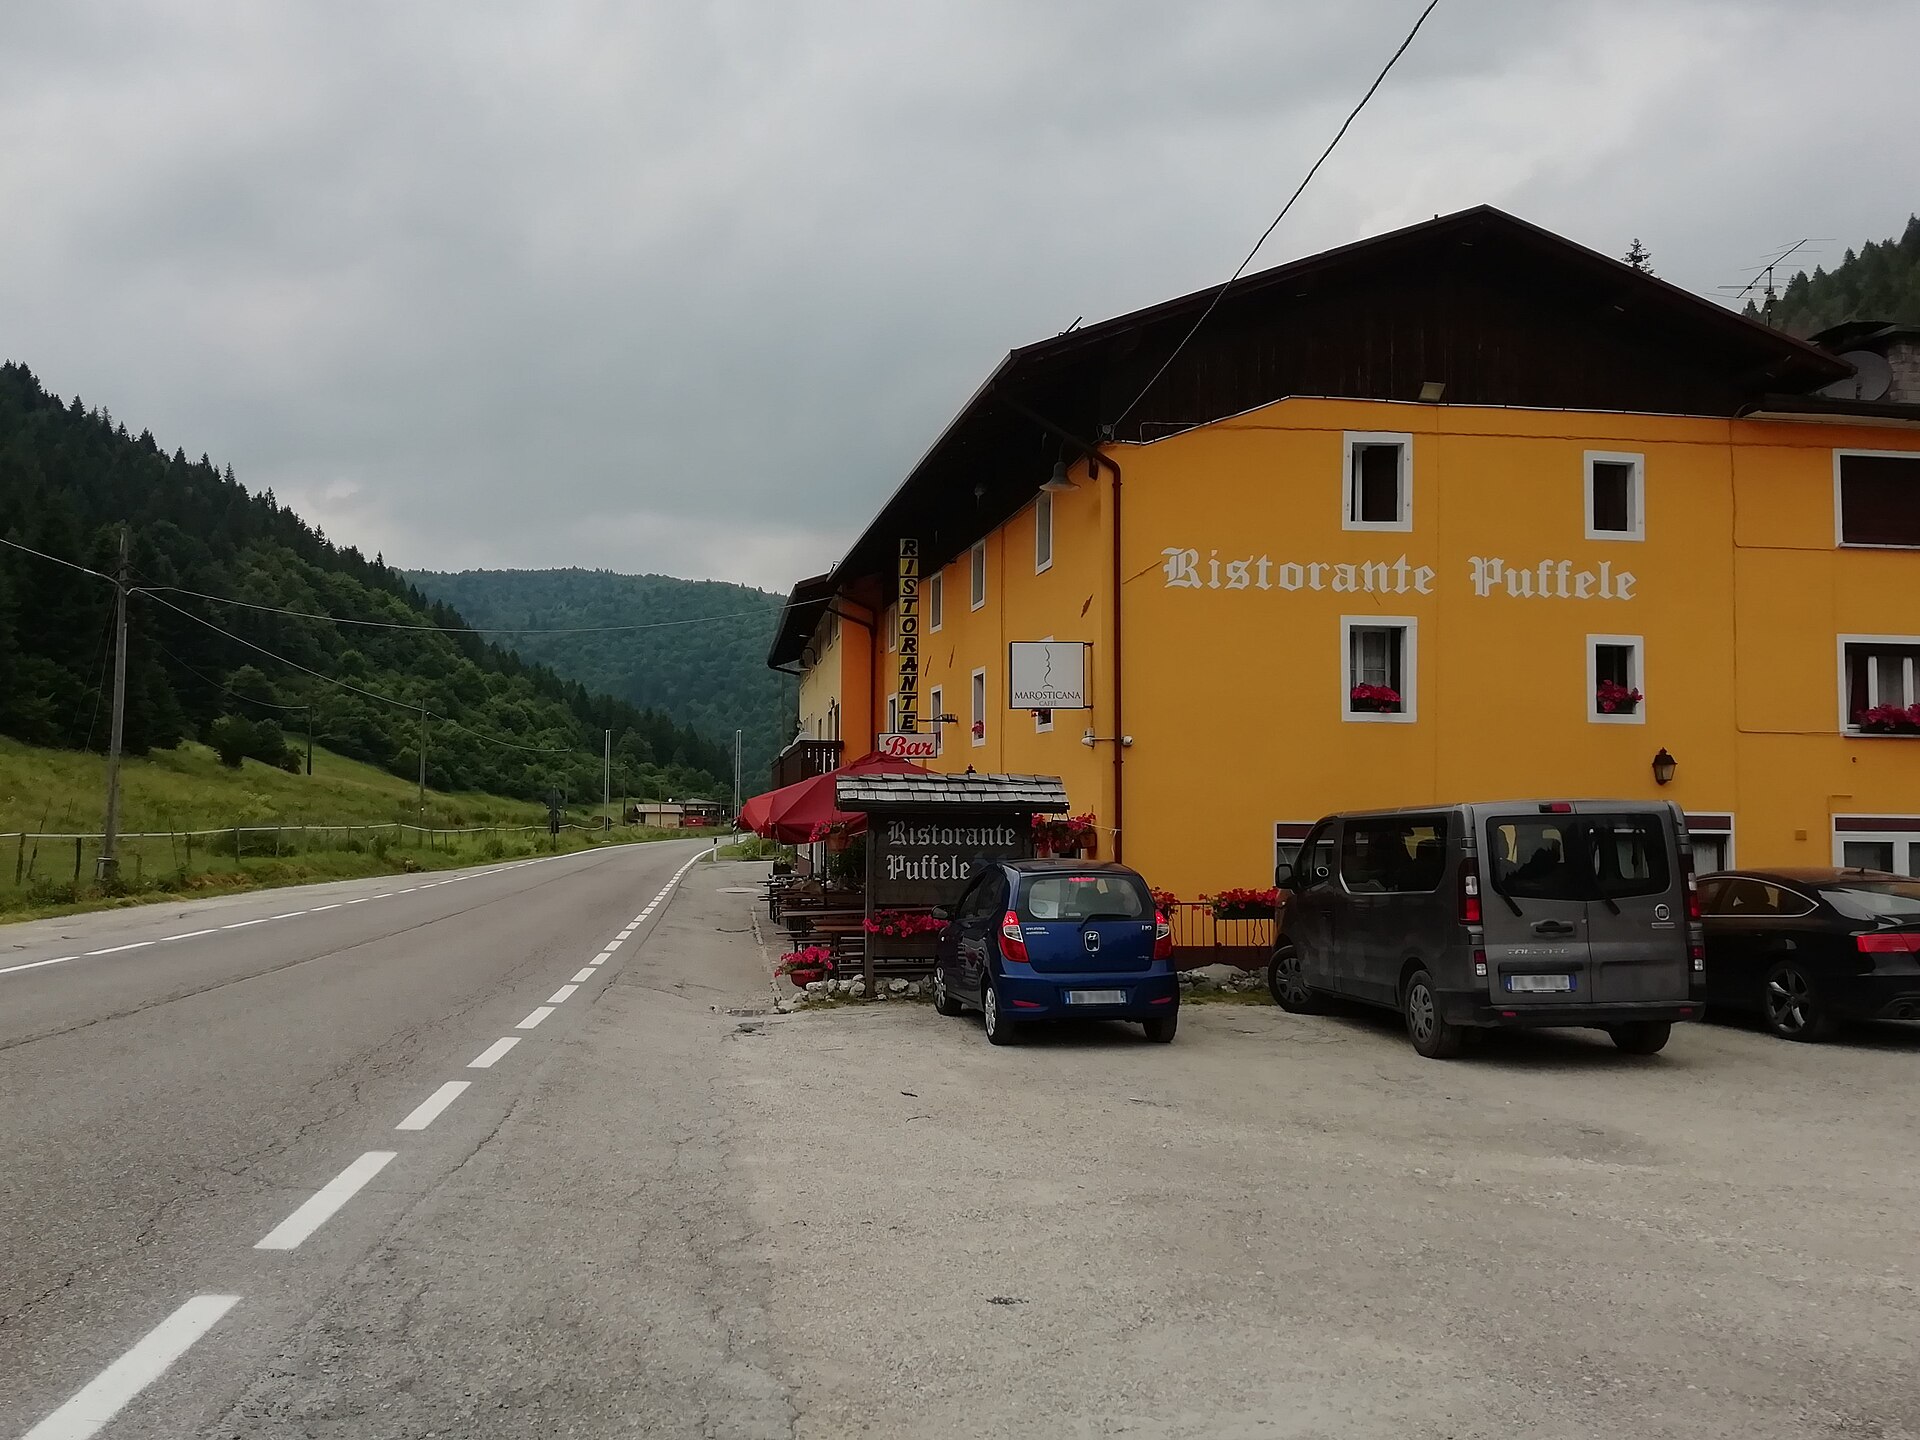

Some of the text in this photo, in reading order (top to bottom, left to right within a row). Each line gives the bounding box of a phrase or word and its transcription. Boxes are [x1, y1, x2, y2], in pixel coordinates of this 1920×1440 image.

[1161, 547, 1637, 600] Ristorante Puffele
[901, 540, 917, 729] RISTORANTE
[1014, 691, 1081, 700] MAROSTICANA
[885, 735, 934, 755] Bar
[887, 820, 1016, 846] Ristorante
[886, 854, 971, 880] Puffele
